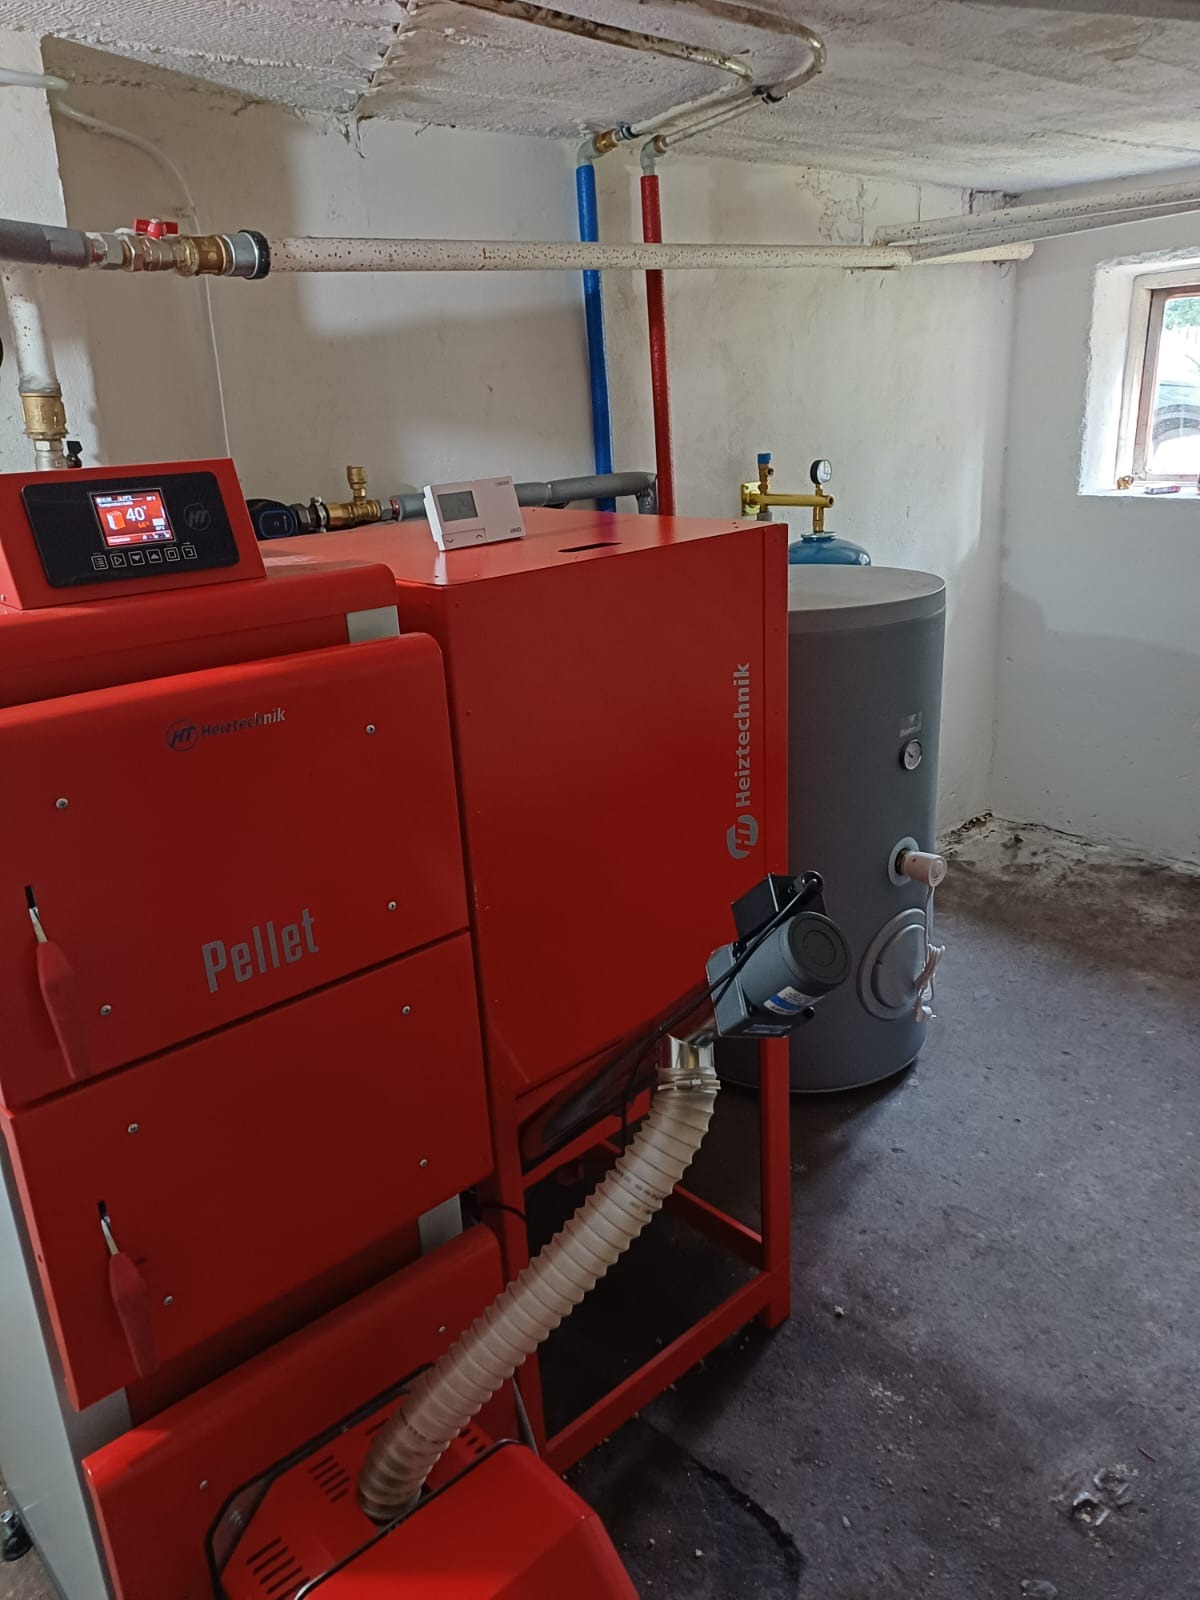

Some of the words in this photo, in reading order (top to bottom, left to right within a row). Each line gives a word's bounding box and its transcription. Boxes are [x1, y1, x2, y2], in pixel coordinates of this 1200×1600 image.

[201, 707, 286, 737] Heiztechnik
[733, 663, 750, 808] Heiztechnik
[201, 908, 319, 993] Pellet
